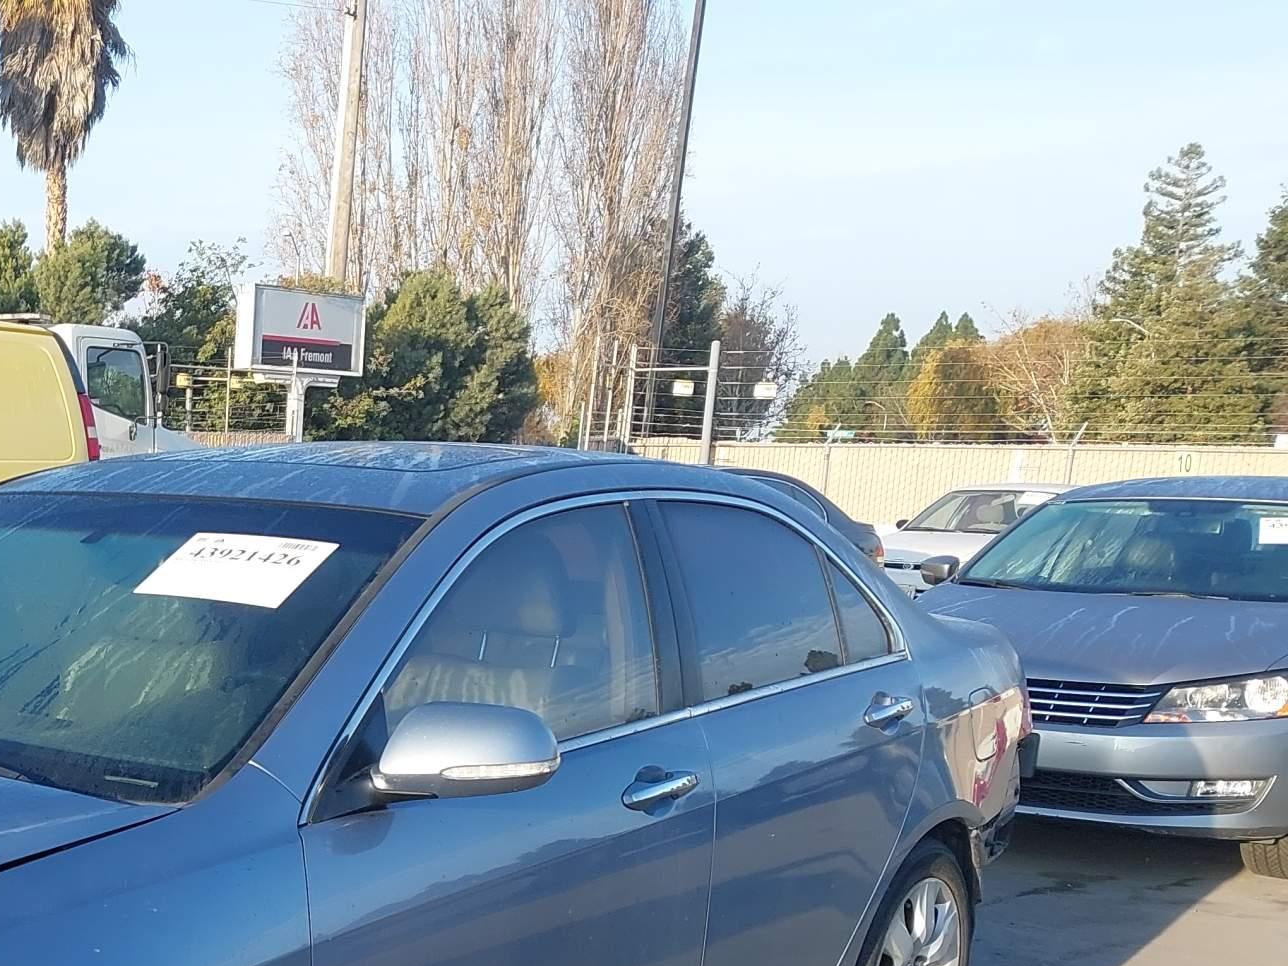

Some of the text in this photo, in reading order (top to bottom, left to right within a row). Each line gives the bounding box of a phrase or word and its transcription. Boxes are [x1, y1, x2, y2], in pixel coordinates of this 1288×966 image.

[300, 348, 332, 363] Fremont
[1178, 454, 1192, 472] 10
[189, 547, 301, 567] 43921426
